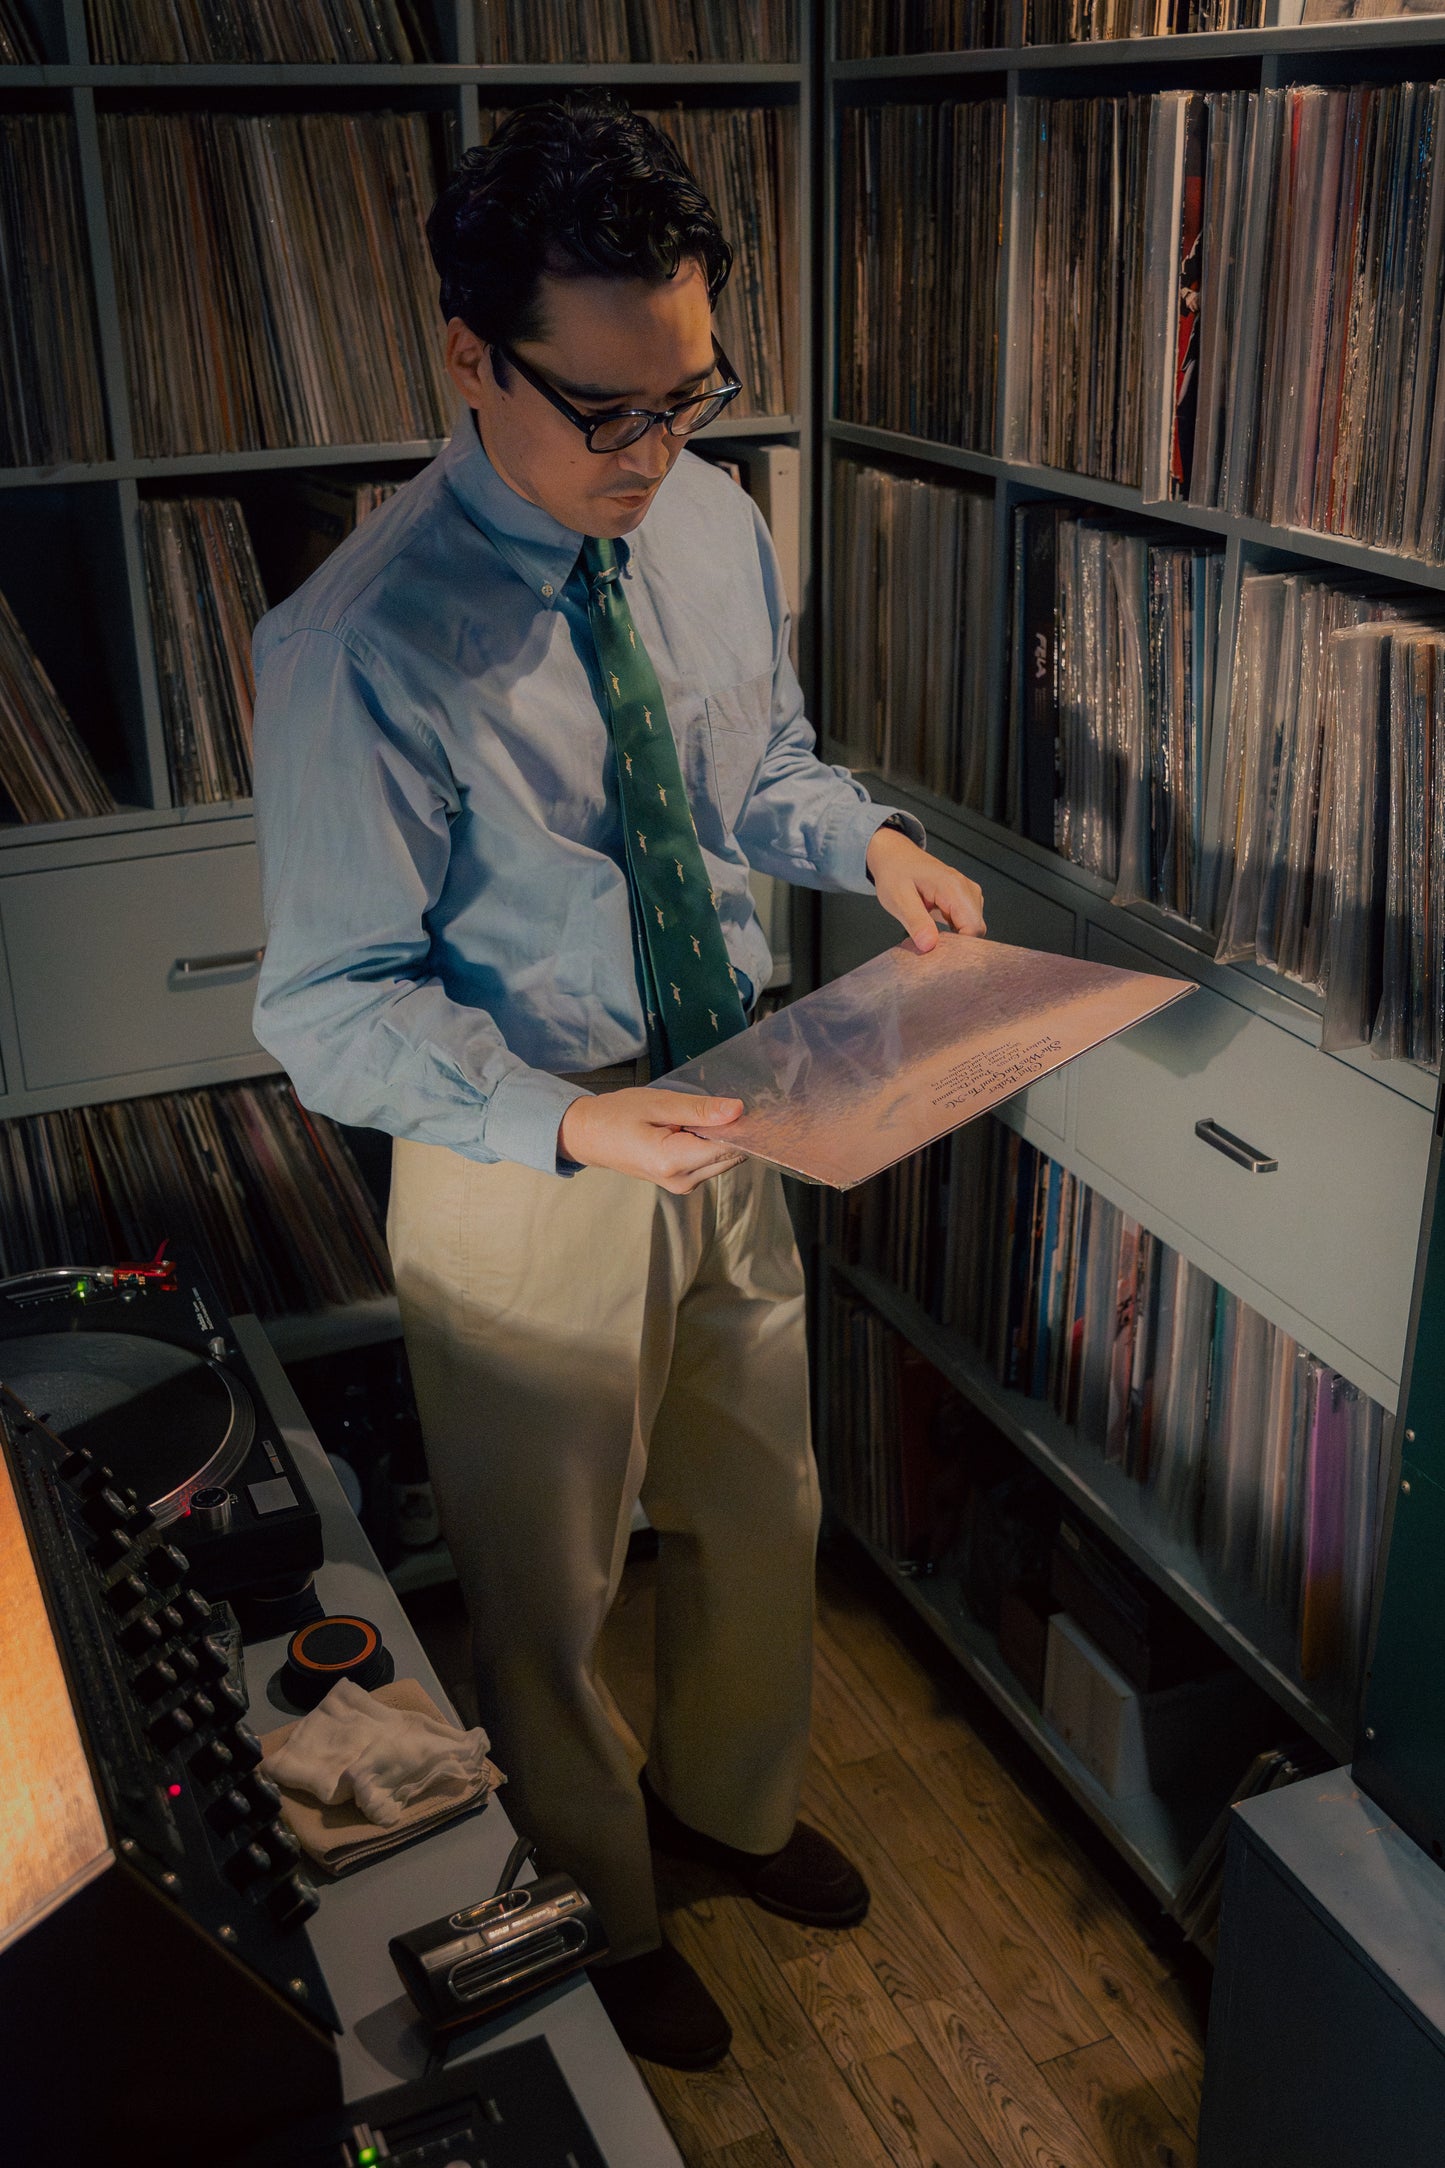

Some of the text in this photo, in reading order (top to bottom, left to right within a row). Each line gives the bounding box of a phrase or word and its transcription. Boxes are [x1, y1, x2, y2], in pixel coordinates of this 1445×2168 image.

[1041, 1040, 1062, 1053] She
[1019, 1053, 1043, 1068] Was
[1004, 1064, 1023, 1073] Too
[979, 1071, 1006, 1090] Good
[988, 1062, 1043, 1094] Chet Baker
